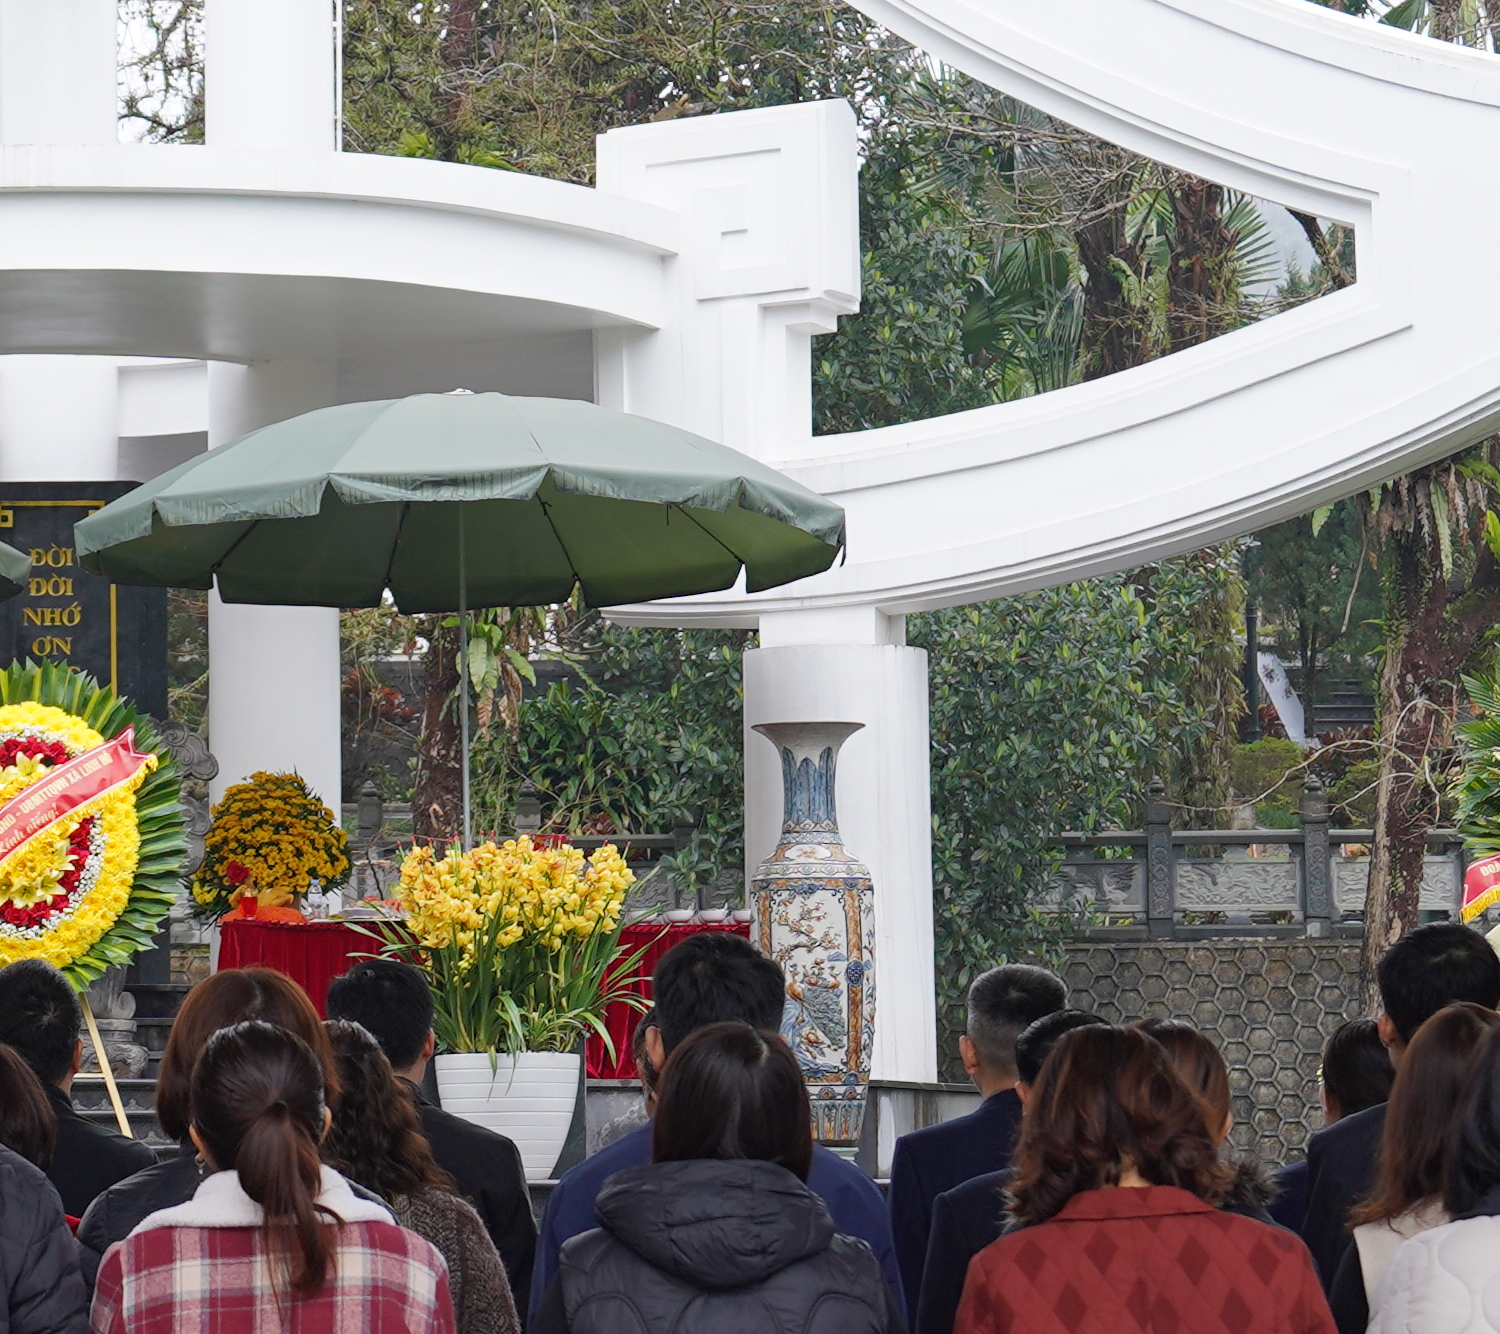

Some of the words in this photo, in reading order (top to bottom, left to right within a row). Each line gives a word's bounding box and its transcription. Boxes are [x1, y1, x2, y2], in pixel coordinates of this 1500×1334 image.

[28, 543, 74, 567] ĐỜI
[28, 573, 74, 596] ĐỜI
[23, 601, 82, 627] NHỚ
[32, 635, 73, 656] ƠN
[20, 777, 69, 814] UBMTTQVN
[66, 768, 82, 785] XÃ
[26, 802, 60, 834] viếng!
